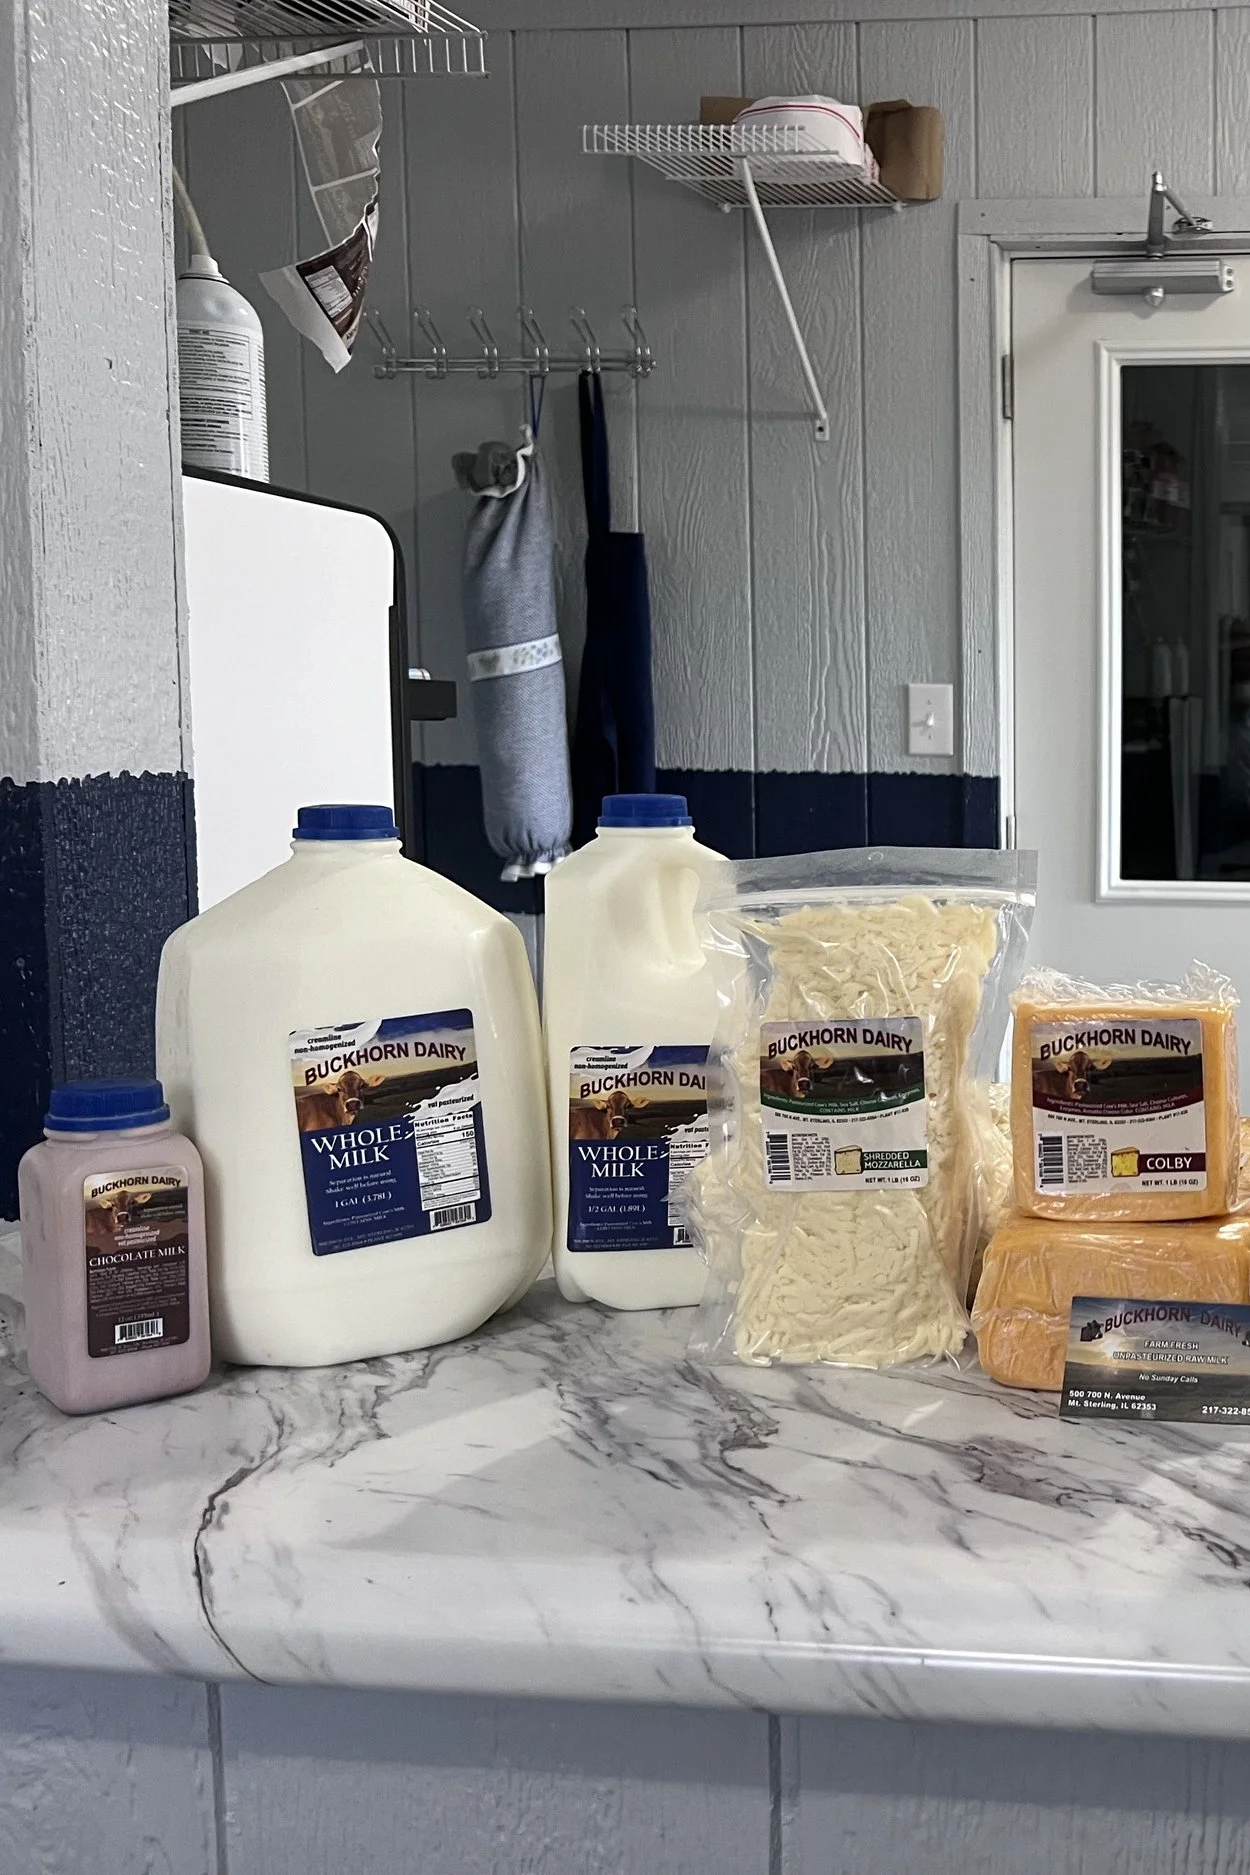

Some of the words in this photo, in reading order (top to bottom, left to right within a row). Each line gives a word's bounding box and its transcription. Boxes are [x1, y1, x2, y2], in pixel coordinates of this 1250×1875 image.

[307, 1034, 342, 1044] creamline
[768, 1028, 858, 1060] BUCKHORN
[862, 1028, 913, 1053] DAIRY
[1040, 1028, 1136, 1061] BUCKHORN
[1141, 1029, 1192, 1055] DAIRY
[294, 1040, 356, 1055] non-homogenized
[304, 1043, 409, 1086] BUCKHORN
[414, 1041, 467, 1061] DAIRY
[574, 1062, 629, 1070] non-homogenized
[580, 1071, 674, 1099] BUCKHORN
[679, 1072, 706, 1090] DAI
[438, 1093, 475, 1108] pasteurized
[414, 1117, 450, 1128] Nutrition
[310, 1124, 404, 1154] WHOLE
[462, 1130, 474, 1138] 150
[329, 1144, 391, 1171] MILK
[578, 1145, 659, 1161] WHOLE
[863, 1151, 910, 1160] SHREDDED
[591, 1162, 645, 1178] MILK
[864, 1159, 921, 1169] MOZZARELLA
[1146, 1156, 1193, 1170] COLBY
[91, 1175, 149, 1198] BUCKHORN
[151, 1175, 181, 1188] DAIRY
[1179, 1179, 1188, 1187] (16
[588, 1205, 600, 1213] 1/2
[600, 1205, 618, 1213] GAL
[89, 1249, 156, 1267] CHOCOLATE
[158, 1245, 186, 1257] MILK
[1104, 1306, 1192, 1333] BUCKHORN
[1200, 1310, 1242, 1338] DAIRY
[1144, 1340, 1168, 1349] FARM
[1170, 1341, 1199, 1350] FRESH
[1113, 1351, 1184, 1363] UNPASTEURIZED
[1185, 1355, 1204, 1363] RAW
[1206, 1356, 1228, 1365] MILK
[1138, 1373, 1149, 1381] No
[1150, 1374, 1178, 1384] Sunday
[1179, 1375, 1199, 1384] Calls
[1069, 1390, 1085, 1398] 500
[1086, 1391, 1102, 1399] 700
[1104, 1391, 1113, 1399] N.
[1115, 1392, 1146, 1401] Avenue
[1068, 1399, 1082, 1408] Mt.
[1083, 1400, 1119, 1411] Sterling,
[1120, 1401, 1129, 1409] IL
[1131, 1402, 1157, 1411] 62353
